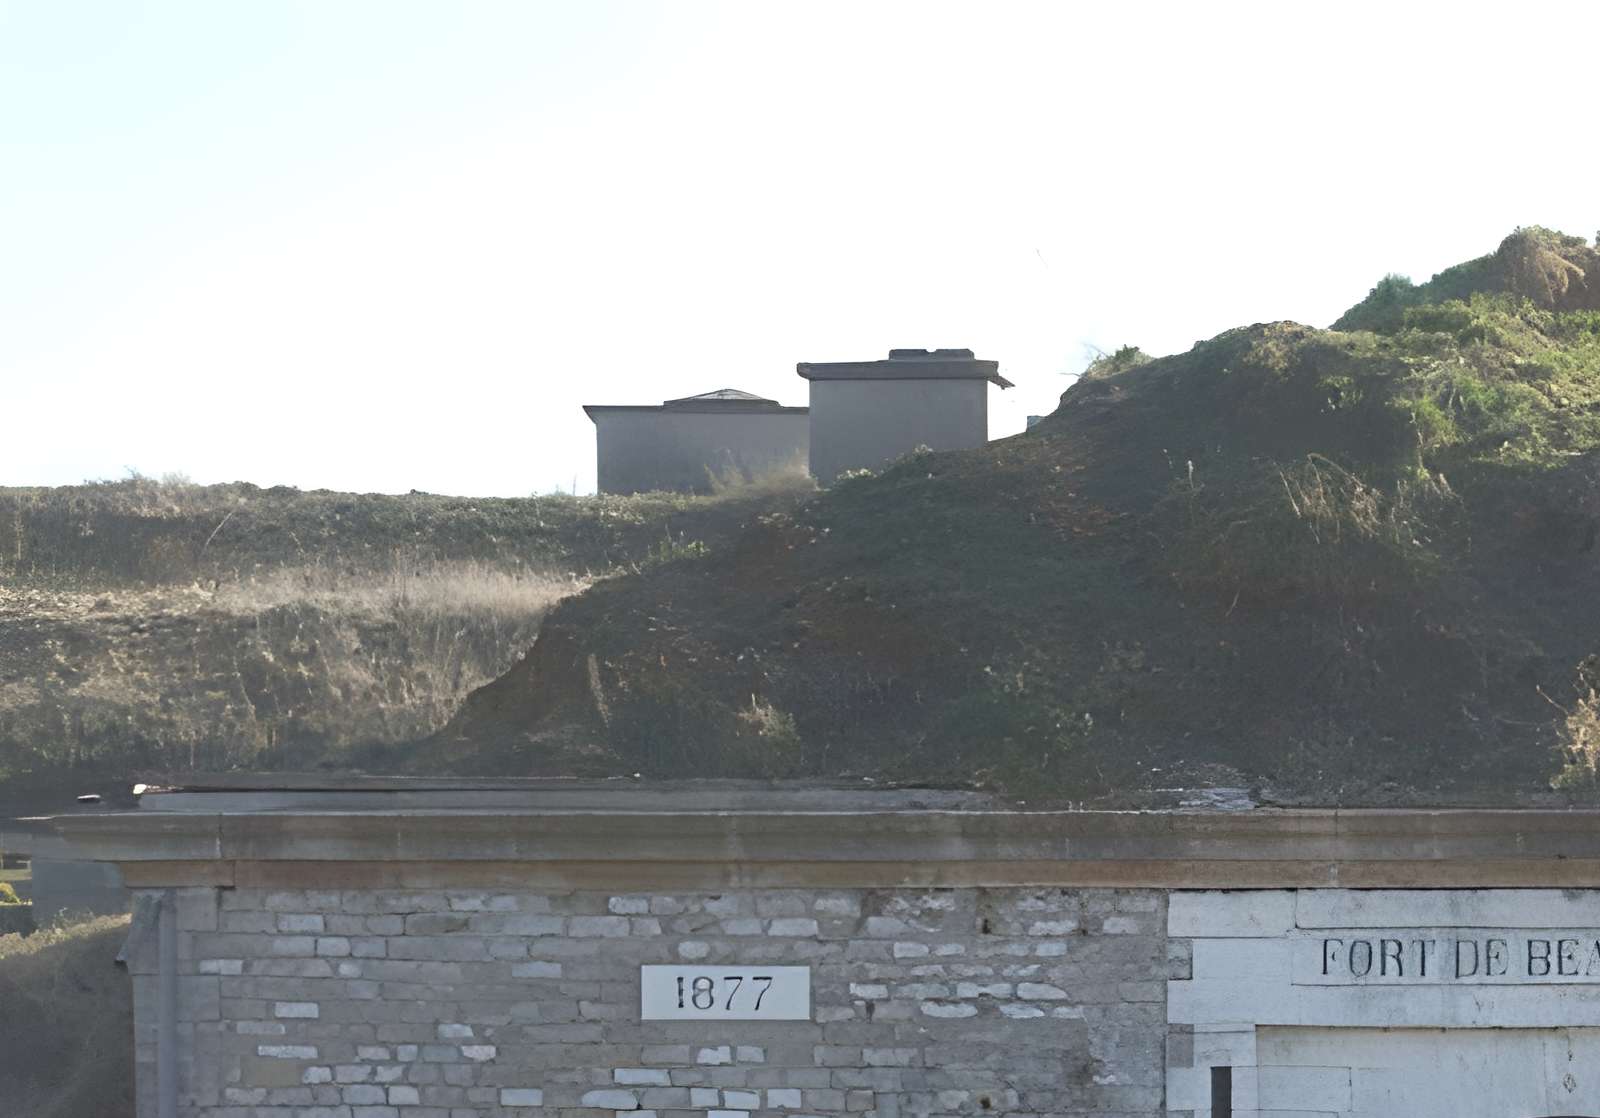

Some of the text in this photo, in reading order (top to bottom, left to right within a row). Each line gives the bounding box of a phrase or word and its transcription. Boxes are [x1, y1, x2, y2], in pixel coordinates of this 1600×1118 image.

[1322, 938, 1436, 977] FORT
[1455, 938, 1508, 979] DE
[676, 975, 773, 1011] 1877
